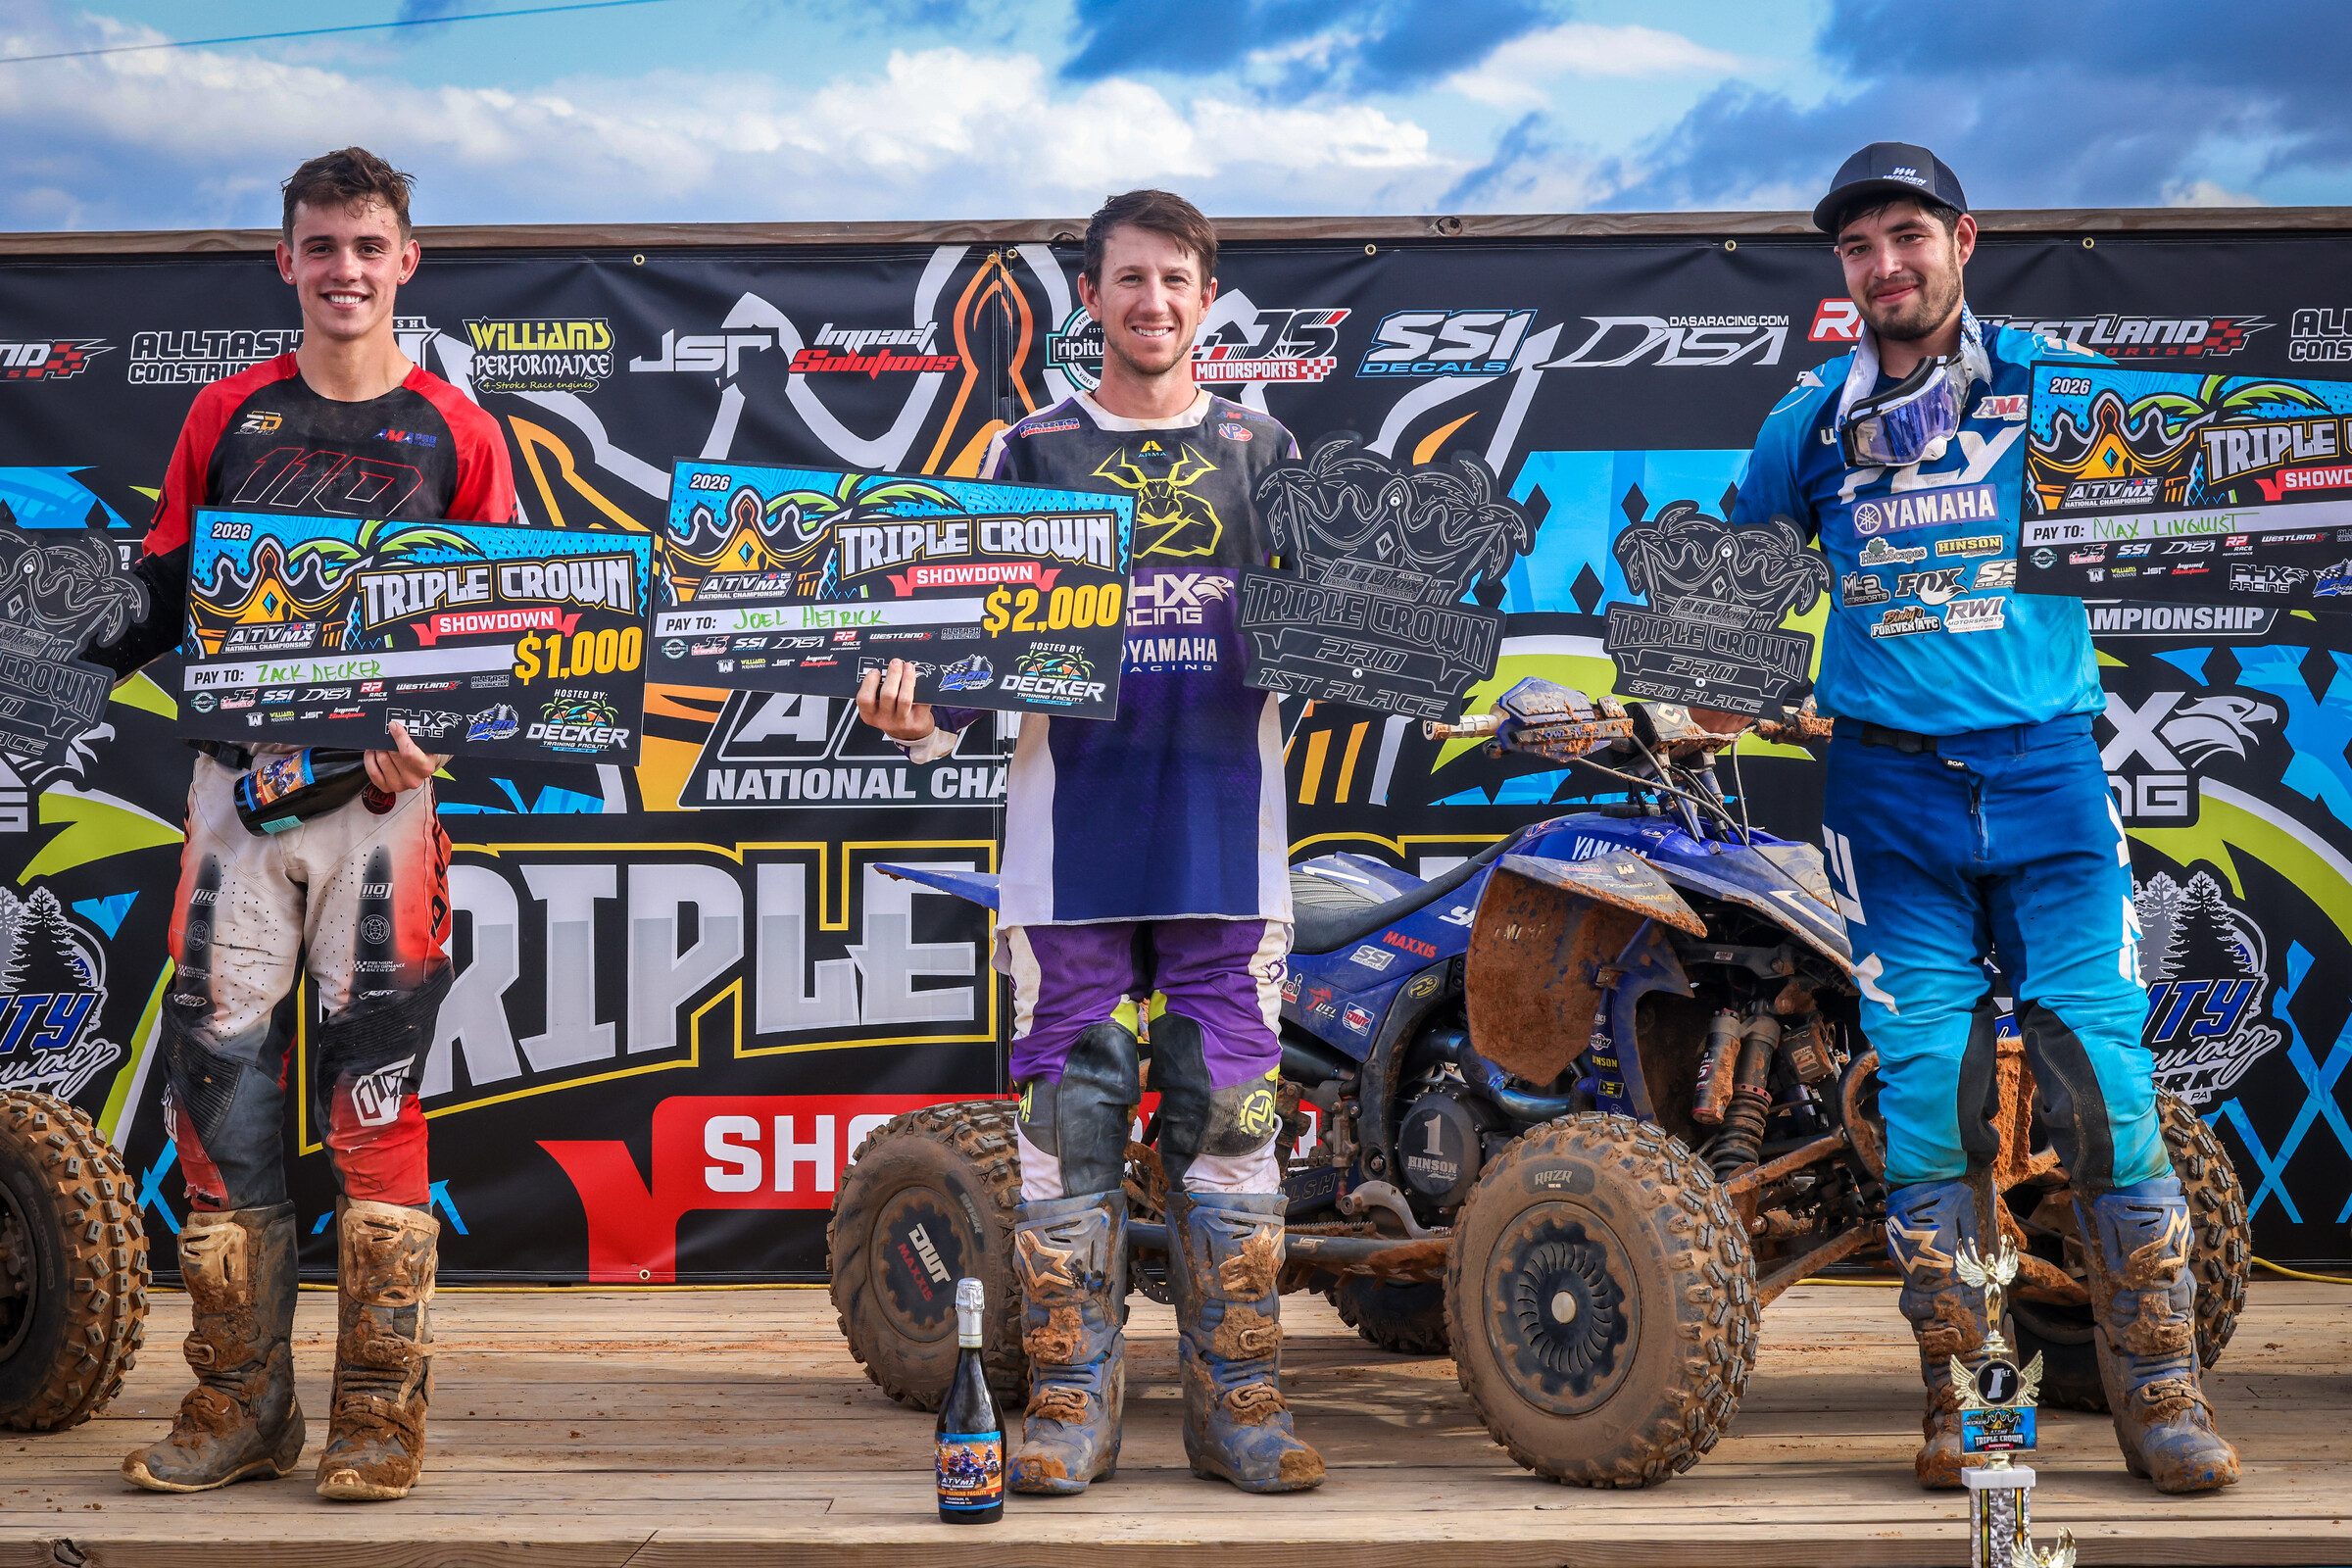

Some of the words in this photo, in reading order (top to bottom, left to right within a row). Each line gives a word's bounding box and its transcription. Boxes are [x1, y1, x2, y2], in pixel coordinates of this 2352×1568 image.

[1670, 316, 1788, 326] DASARACING.COM
[470, 322, 611, 350] WILLIAMS
[814, 322, 938, 354] Impact
[1369, 314, 1533, 361] SSI
[1536, 317, 1788, 368] DASA
[474, 355, 610, 379] PERFORMANCE
[789, 349, 960, 379] Solutions
[1196, 362, 1298, 380] MOTORSPORTS
[1361, 362, 1507, 373] DECALS
[557, 381, 594, 390] engines
[2050, 378, 2090, 394] 2026
[372, 428, 414, 444] AMA
[2204, 423, 2335, 480] TRIPLE
[690, 474, 730, 490] 2026
[1883, 489, 1995, 529] YAMAHA
[2099, 497, 2152, 506] CHAMPIONSHIP
[212, 523, 251, 539] 2026
[2034, 526, 2060, 540] PAY
[2064, 525, 2083, 538] TO:
[839, 522, 969, 575] TRIPLE
[981, 516, 1111, 569] CROWN
[1937, 538, 2001, 552] HINSON
[2117, 543, 2152, 555] SSI
[2227, 536, 2247, 546] RP
[917, 565, 1033, 584] SHOWDOWN
[1895, 566, 1964, 597] FOX
[2230, 564, 2289, 582] PHX
[362, 568, 489, 624] TRIPLE
[501, 560, 630, 612] CROWN
[733, 590, 785, 599] CHAMPIONSHIP
[2230, 581, 2290, 593] RACING
[733, 608, 787, 629] JOEL
[803, 606, 890, 628] HETRICK
[984, 583, 1123, 639] $2,000
[1885, 607, 1924, 624] Binky's
[1946, 599, 2004, 620] RWI
[440, 611, 554, 632] SHOWDOWN
[665, 617, 692, 631] PAY
[696, 616, 716, 629] TO:
[1245, 577, 1366, 627] TRIPLE
[1372, 600, 1494, 669] CROWN
[1873, 620, 1916, 637] FOREVER
[1917, 618, 1938, 630] ATC
[1947, 616, 2003, 626] MOTORSPORTS
[733, 637, 768, 649] SSI
[834, 631, 857, 640] RP
[869, 632, 923, 641] WESTLAND
[225, 643, 258, 652] NATIONAL
[1030, 642, 1066, 653] HOSTED
[1068, 645, 1085, 654] BY:
[1129, 638, 1217, 662] YAMAHA
[1314, 638, 1408, 672] PRO
[1612, 612, 1705, 648] TRIPLE
[1710, 627, 1807, 680] CROWN
[515, 627, 643, 685] $1,000
[195, 670, 220, 684] PAY
[223, 669, 244, 682] TO:
[256, 664, 306, 683] ZACK
[312, 660, 386, 682] DECKER
[1666, 657, 1740, 682] PRO
[0, 656, 104, 720] CROWN
[262, 690, 295, 701] SSI
[362, 682, 382, 692] RP
[555, 689, 589, 699] HOSTED
[593, 691, 608, 700] BY:
[1000, 675, 1105, 702] DECKER
[1257, 667, 1324, 693] 1ST
[1323, 679, 1448, 719] PLACE
[1628, 679, 1680, 699] 3RD
[1681, 688, 1764, 713] PLACE
[526, 723, 629, 749] DECKER
[707, 768, 916, 800] NATIONAL
[363, 884, 385, 895] 110
[1633, 893, 1673, 902] TRIANGLE
[1383, 931, 1438, 958] MAXXIS
[421, 861, 976, 1101] RIPLE
[1423, 1114, 1444, 1156] 1
[1408, 1156, 1458, 1173] HINSON
[1289, 1173, 1337, 1204] LSH
[897, 1243, 934, 1302] MAXXIS
[1975, 1435, 1999, 1446] TRIPLE
[2000, 1434, 2024, 1445] CROWN
